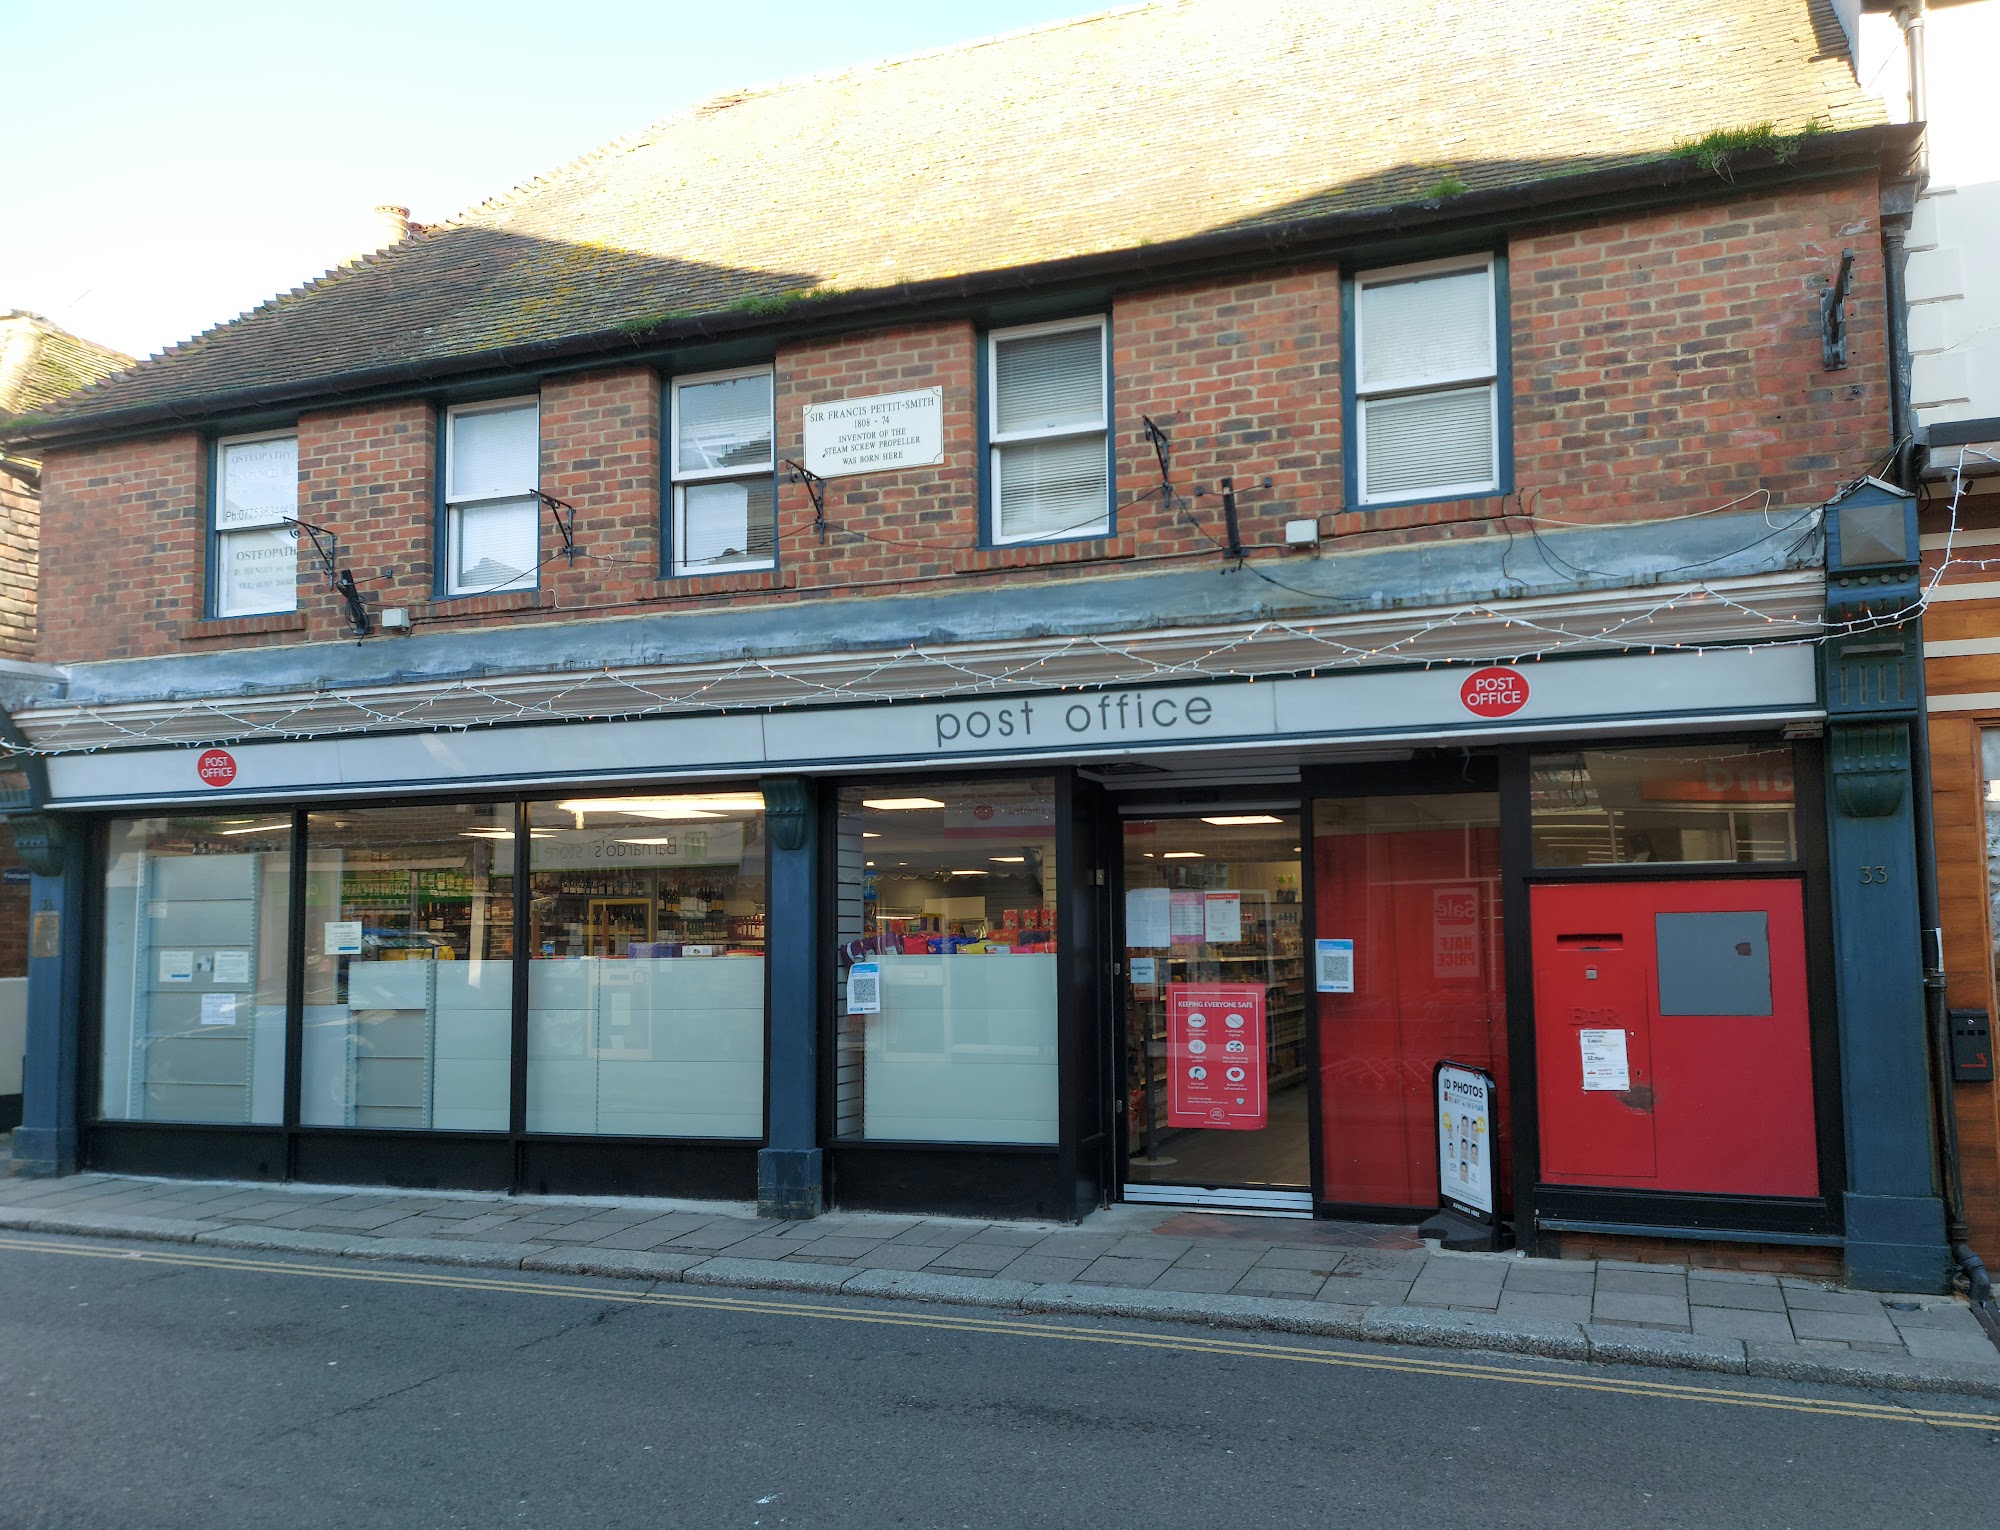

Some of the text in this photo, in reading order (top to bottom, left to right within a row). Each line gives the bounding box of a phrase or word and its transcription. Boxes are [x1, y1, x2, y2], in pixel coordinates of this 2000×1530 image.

[810, 397, 935, 423] SIR FRANCIS PETTIT-SMITH
[854, 417, 871, 429] 1808
[881, 415, 890, 425] 74
[838, 427, 907, 444] INVENTOR OF THE
[824, 436, 921, 456] STEAM SCREW PROPELLER
[231, 450, 291, 465] OSTEOPATHY
[842, 450, 904, 466] WAS BORN HERE
[1476, 676, 1515, 691] POST
[1467, 690, 1521, 706] OFFICE
[936, 693, 1212, 748] post office
[205, 756, 229, 767] POST
[201, 767, 234, 778] OFFICE
[1859, 866, 1889, 884] 33
[1443, 1078, 1451, 1090] ID
[1452, 1080, 1484, 1099] PHOTOS
